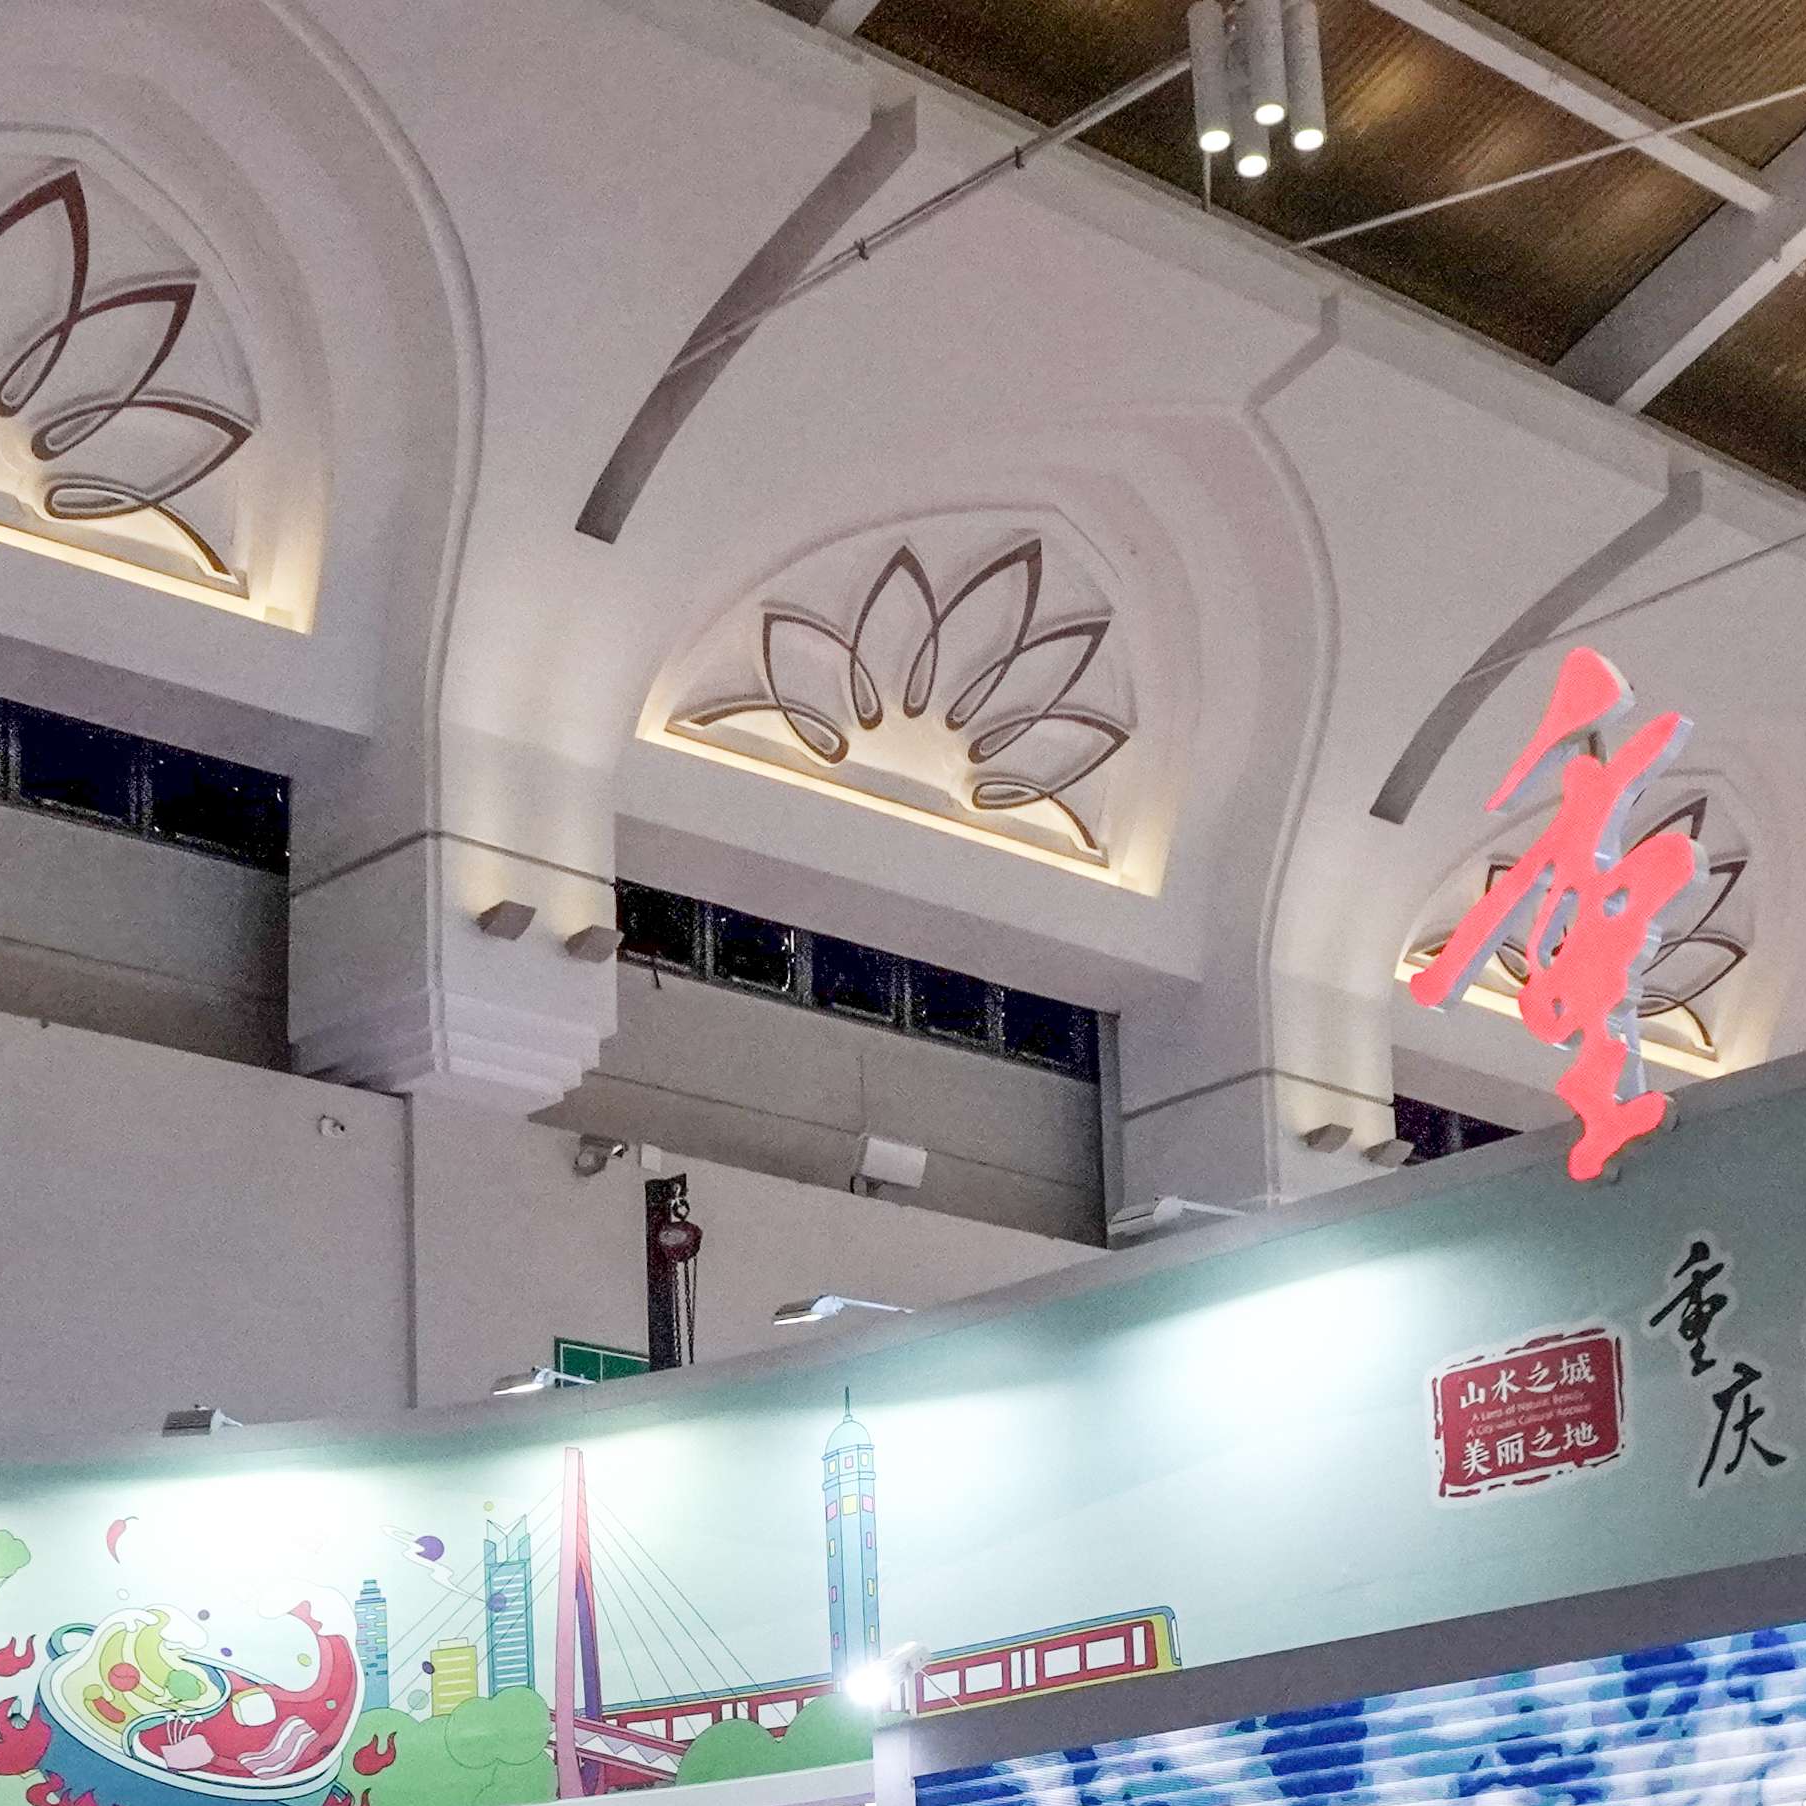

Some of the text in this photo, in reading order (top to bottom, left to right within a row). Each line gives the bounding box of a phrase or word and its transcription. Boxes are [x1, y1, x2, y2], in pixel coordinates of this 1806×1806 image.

[1460, 1353, 1595, 1409] 山水之城
[1649, 1241, 1788, 1488] 重庆
[1462, 1421, 1600, 1480] 美丽之地
